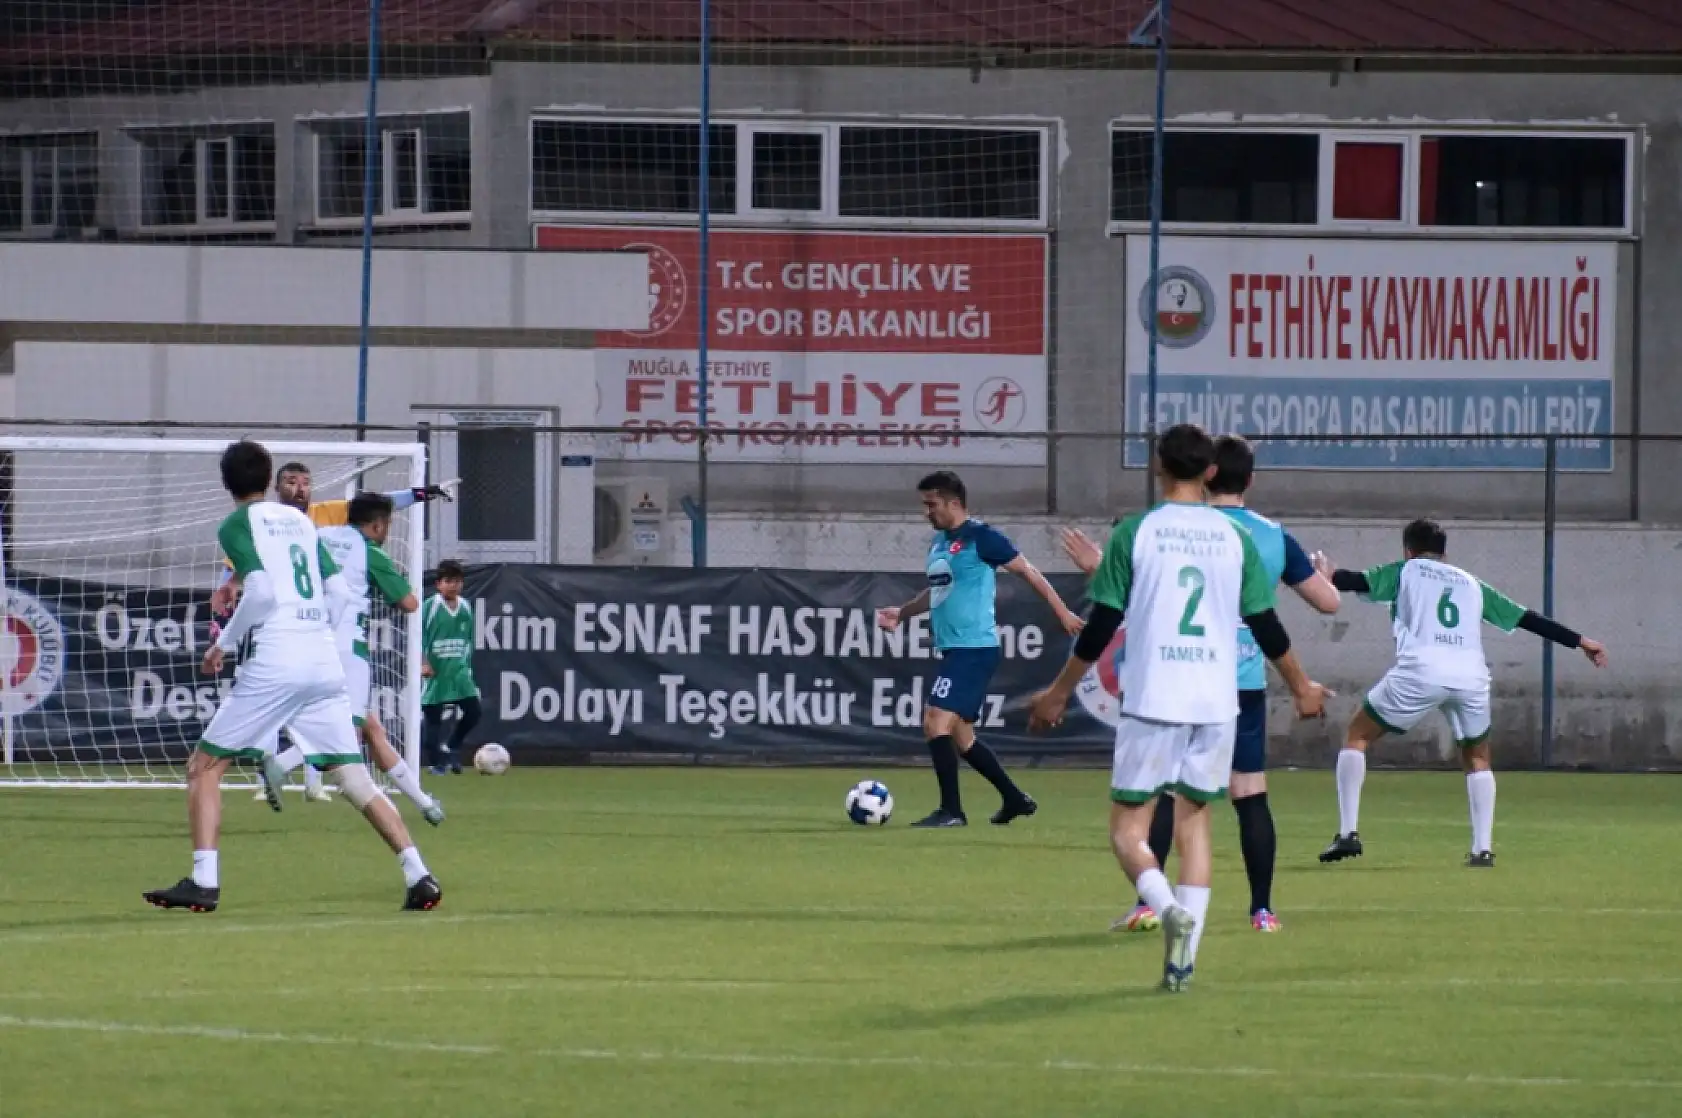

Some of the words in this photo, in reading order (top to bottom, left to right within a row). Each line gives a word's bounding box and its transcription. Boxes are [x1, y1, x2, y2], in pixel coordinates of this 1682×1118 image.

[717, 261, 773, 290] T.C.
[781, 256, 921, 298] GENÇLİK
[931, 263, 971, 291] VE
[716, 307, 804, 336] SPOR
[813, 304, 991, 338] BAKANLIĞI
[1229, 254, 1352, 359] FETHİYE
[1362, 256, 1601, 363] KAYMAKAMLIĞI
[628, 356, 690, 376] MUĞLA
[625, 373, 961, 417] FETHİYE
[621, 418, 727, 444] SPOR
[737, 418, 961, 448] KOMPLEKSİ
[1251, 393, 1344, 448] SPOR'A
[1351, 395, 1496, 462] BAŞARILAR
[288, 543, 315, 600] 8
[1177, 564, 1206, 637] 2
[1436, 587, 1460, 629] 6
[97, 592, 198, 651] Özel
[475, 597, 557, 651] kim
[574, 603, 713, 656] ESNAF
[500, 671, 644, 736] Dolayı
[659, 672, 854, 738] Teşekkür
[930, 675, 953, 699] 18
